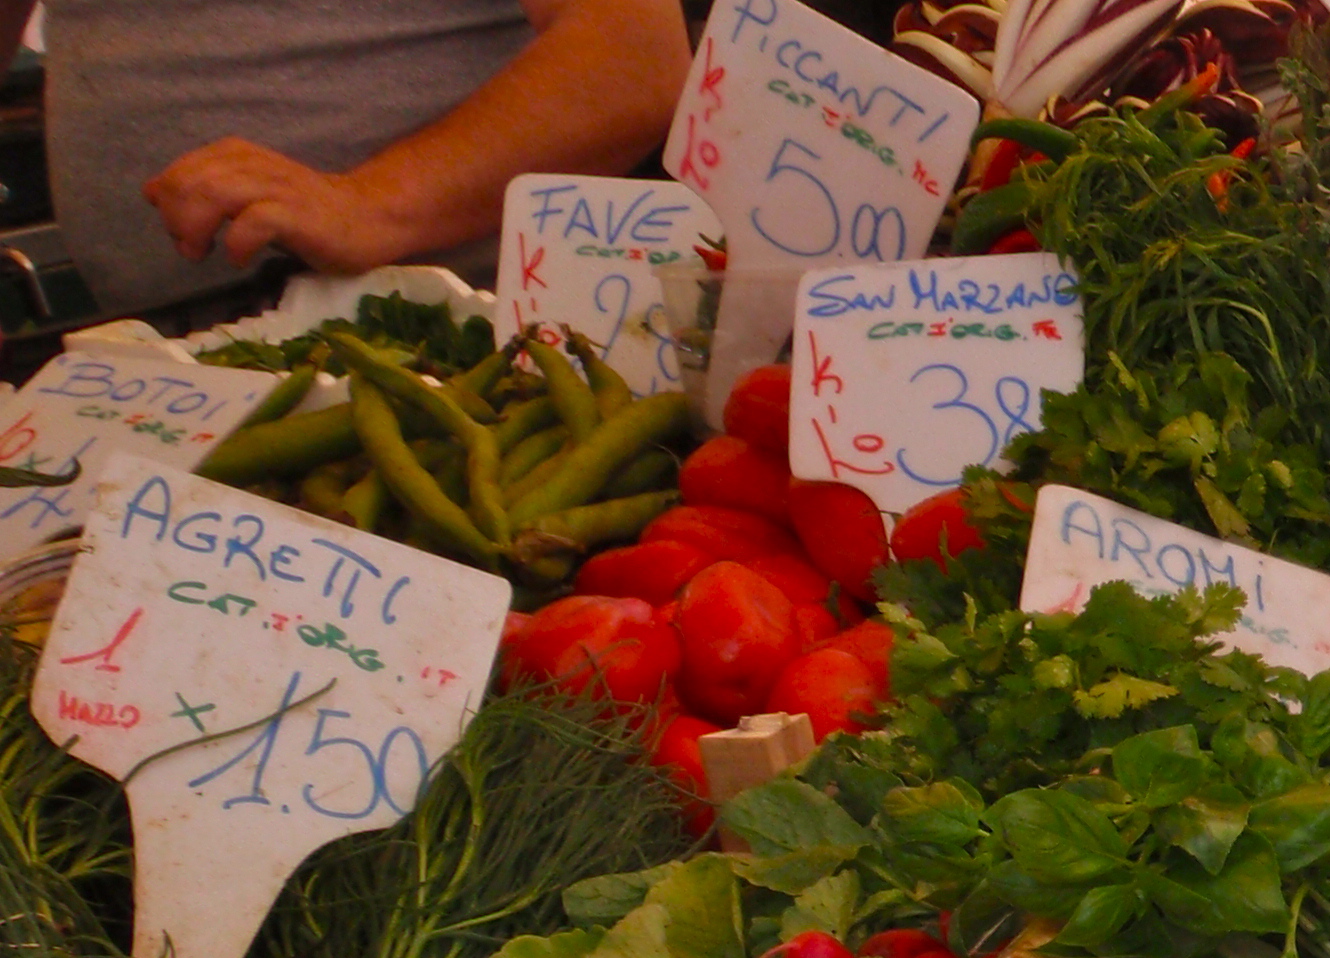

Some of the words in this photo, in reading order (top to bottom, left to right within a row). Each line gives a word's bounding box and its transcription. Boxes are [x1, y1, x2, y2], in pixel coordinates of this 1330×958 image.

[531, 185, 691, 245] FAVE
[808, 275, 895, 317] SAN
[120, 475, 411, 625] AGRETTI
[1061, 500, 1265, 612] AROMI
[188, 671, 431, 820] 1.50
